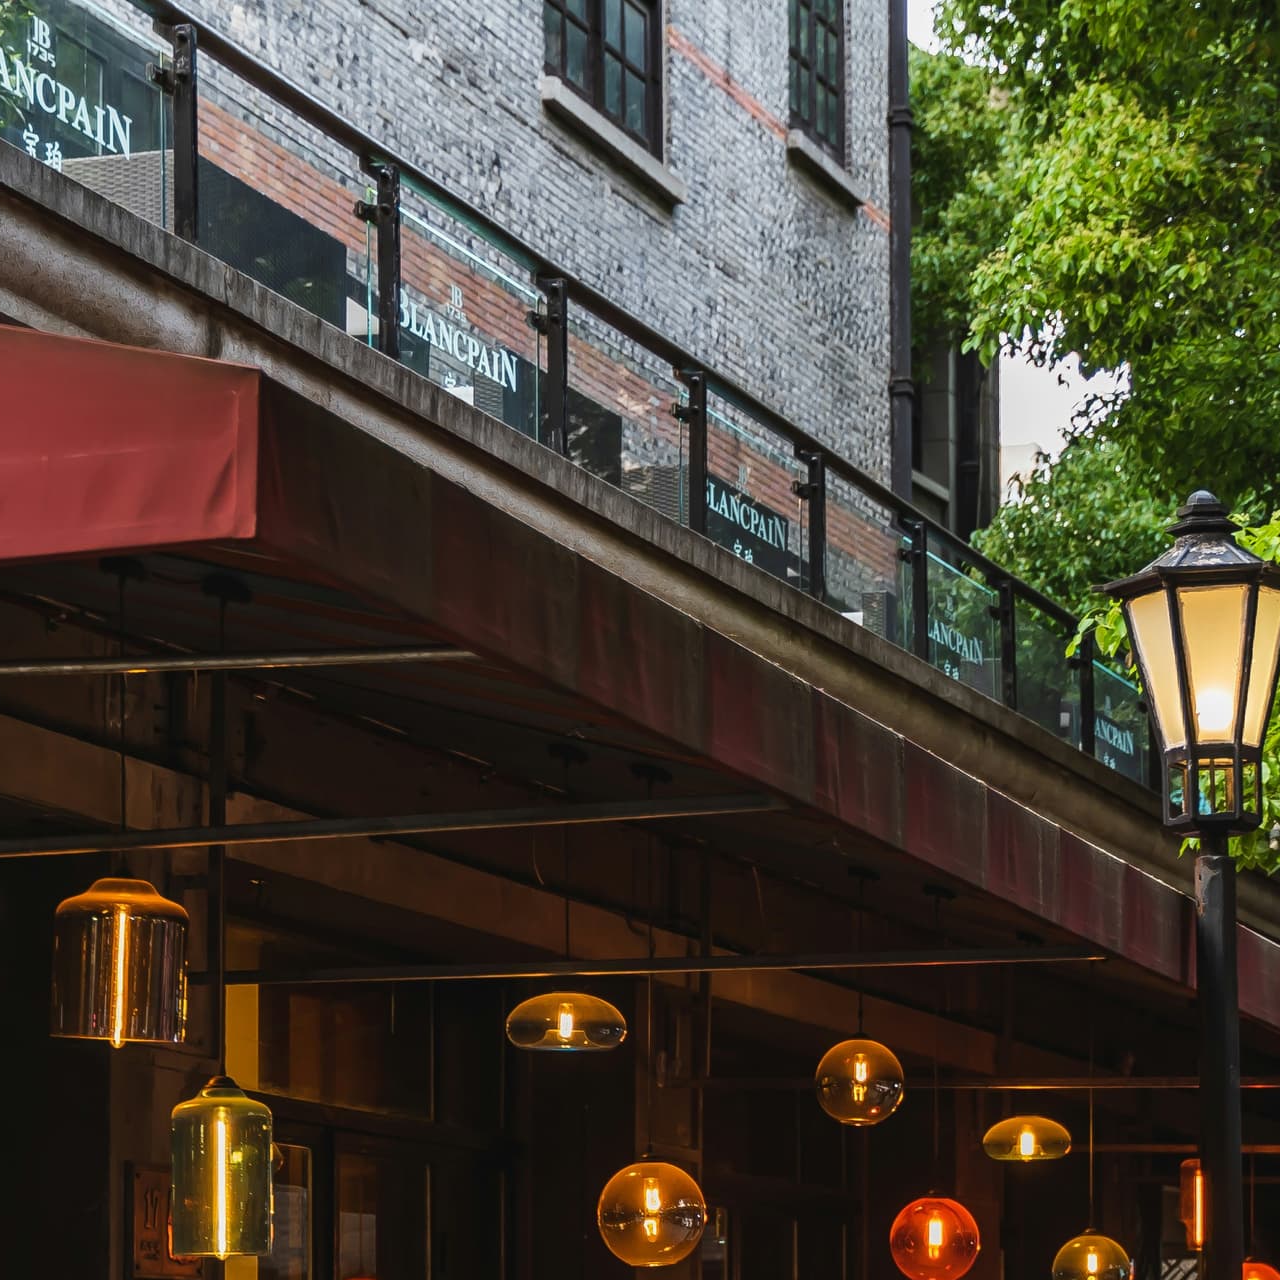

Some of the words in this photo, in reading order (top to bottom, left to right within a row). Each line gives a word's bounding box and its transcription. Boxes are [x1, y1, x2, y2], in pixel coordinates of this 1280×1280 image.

[27, 39, 56, 68] 1735
[706, 479, 787, 552] LANCPAIN
[927, 617, 984, 667] LANCPAIN
